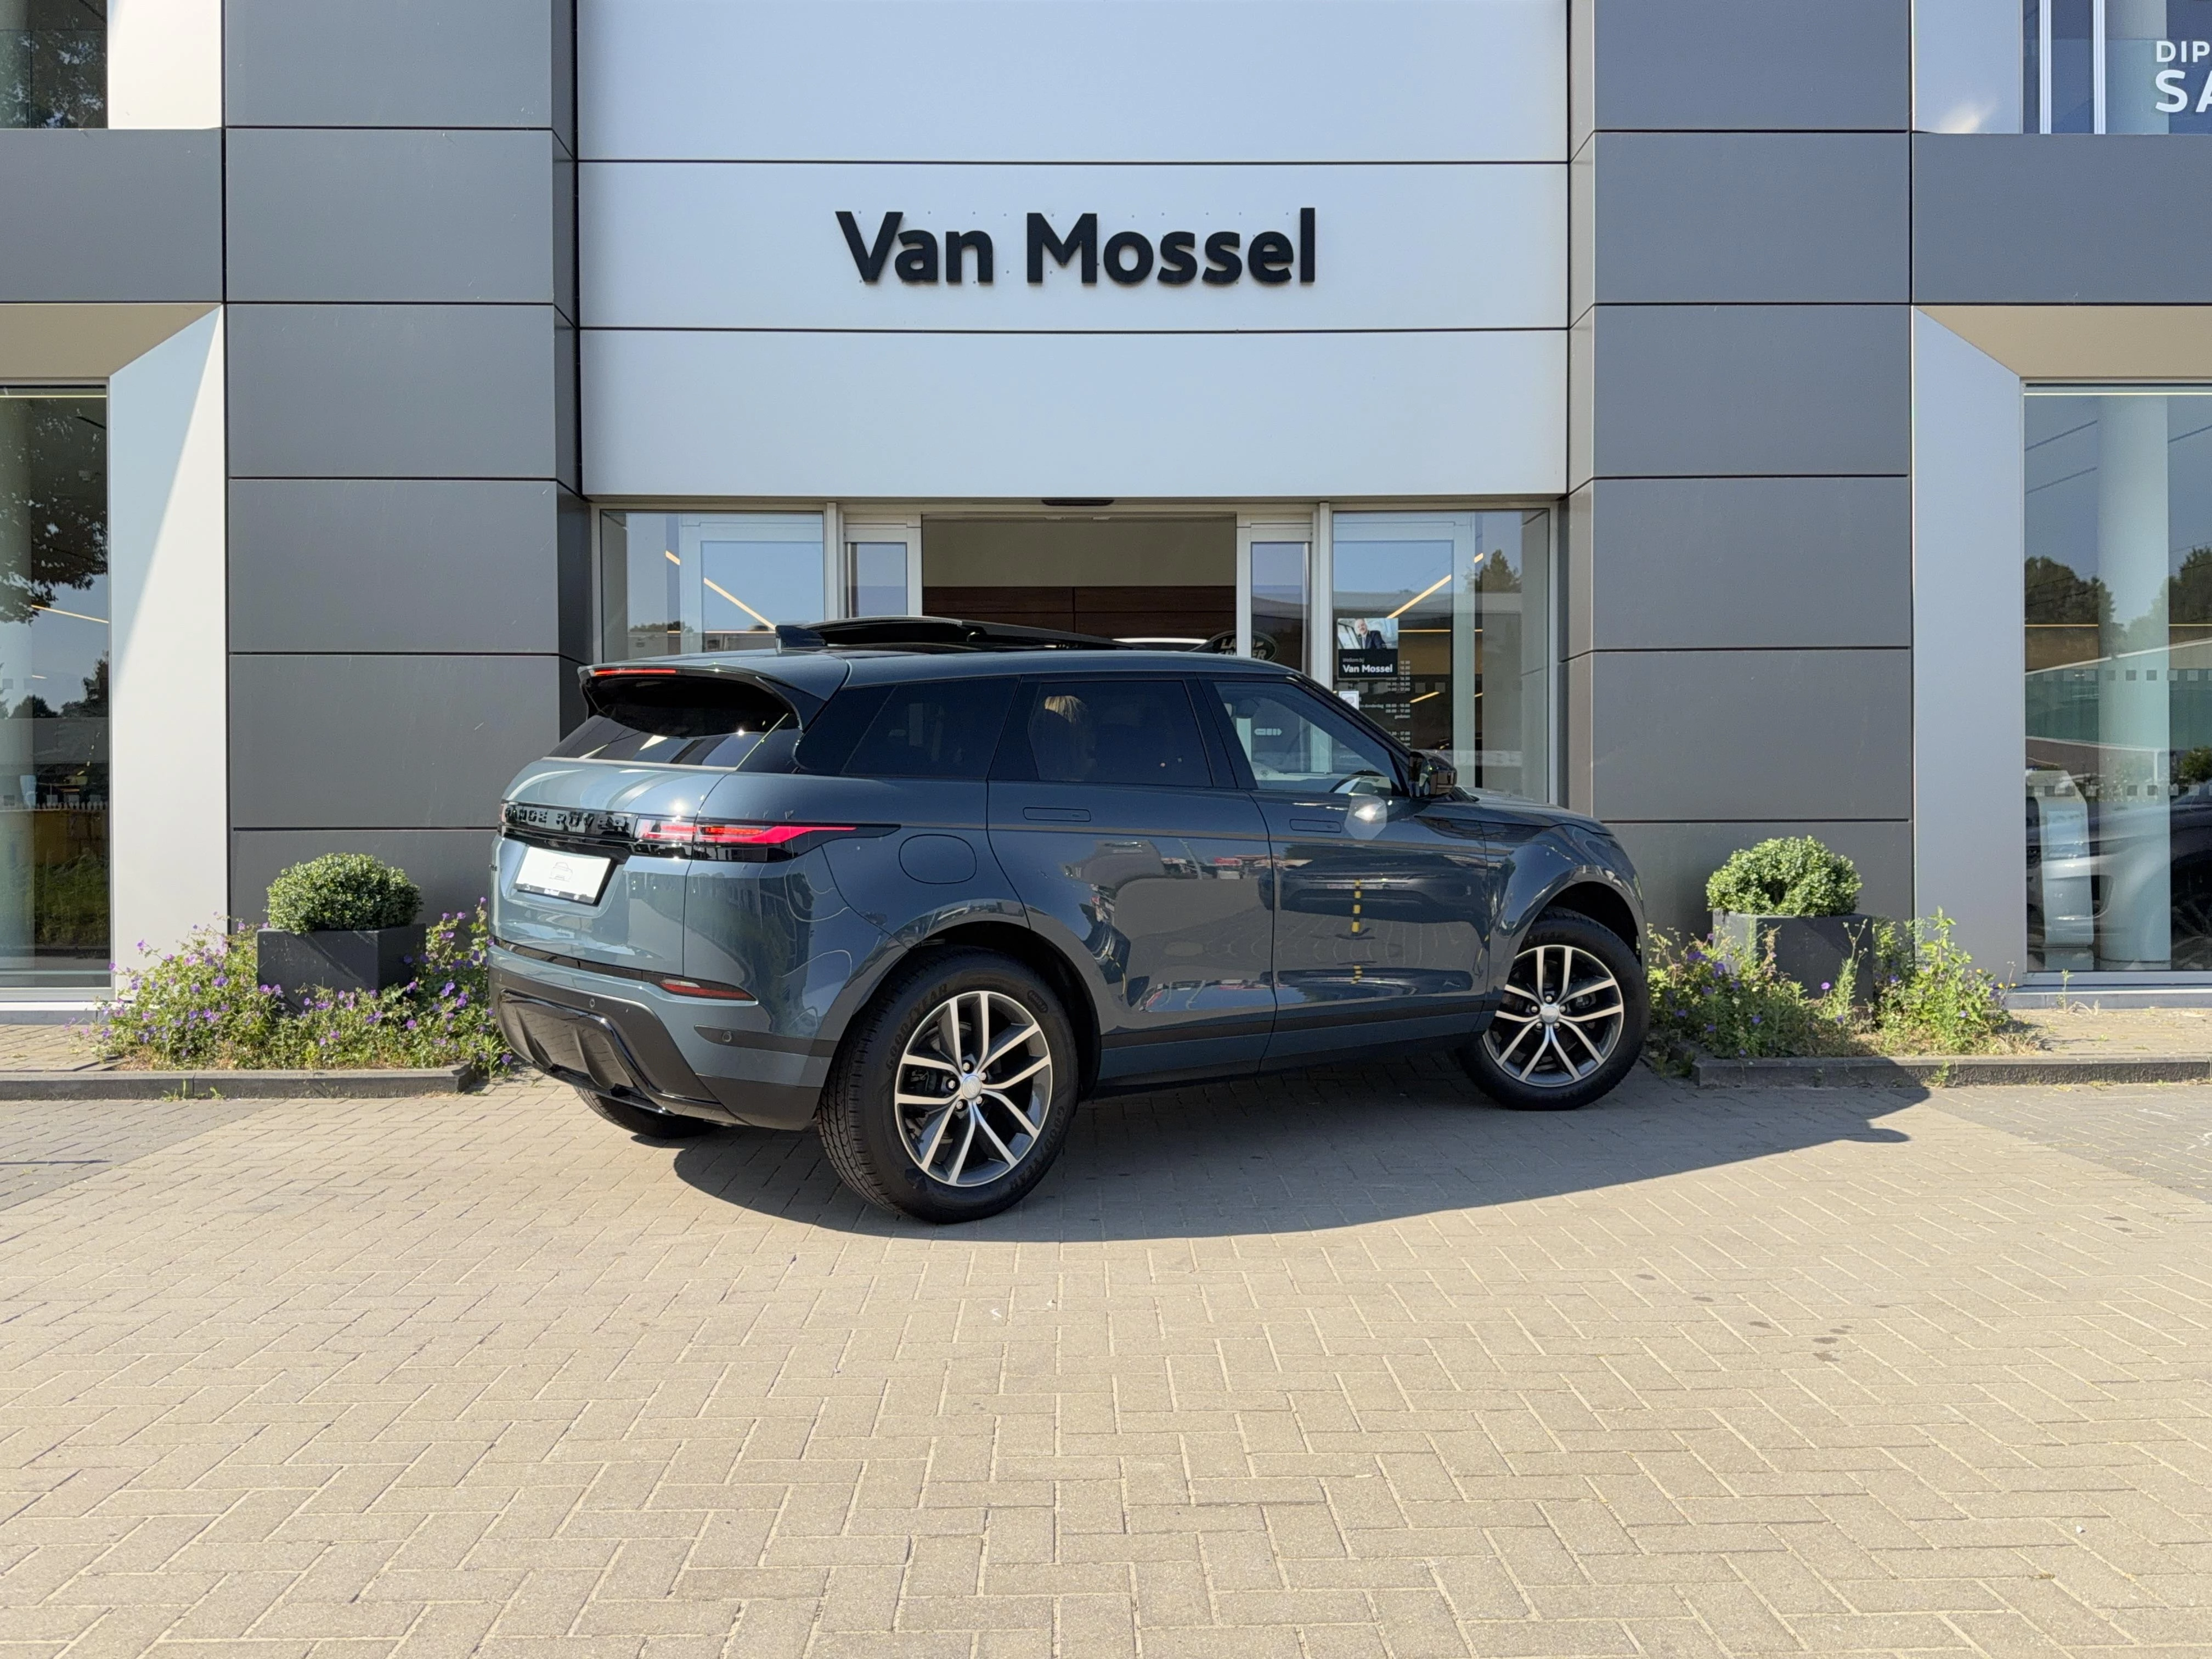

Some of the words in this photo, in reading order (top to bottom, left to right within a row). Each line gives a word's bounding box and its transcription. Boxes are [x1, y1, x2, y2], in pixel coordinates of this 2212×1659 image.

[2156, 41, 2210, 63] DIP
[834, 211, 994, 284] Van
[1026, 207, 1316, 285] Mossel
[1342, 664, 1360, 673] Van
[1362, 664, 1393, 673] Mossel
